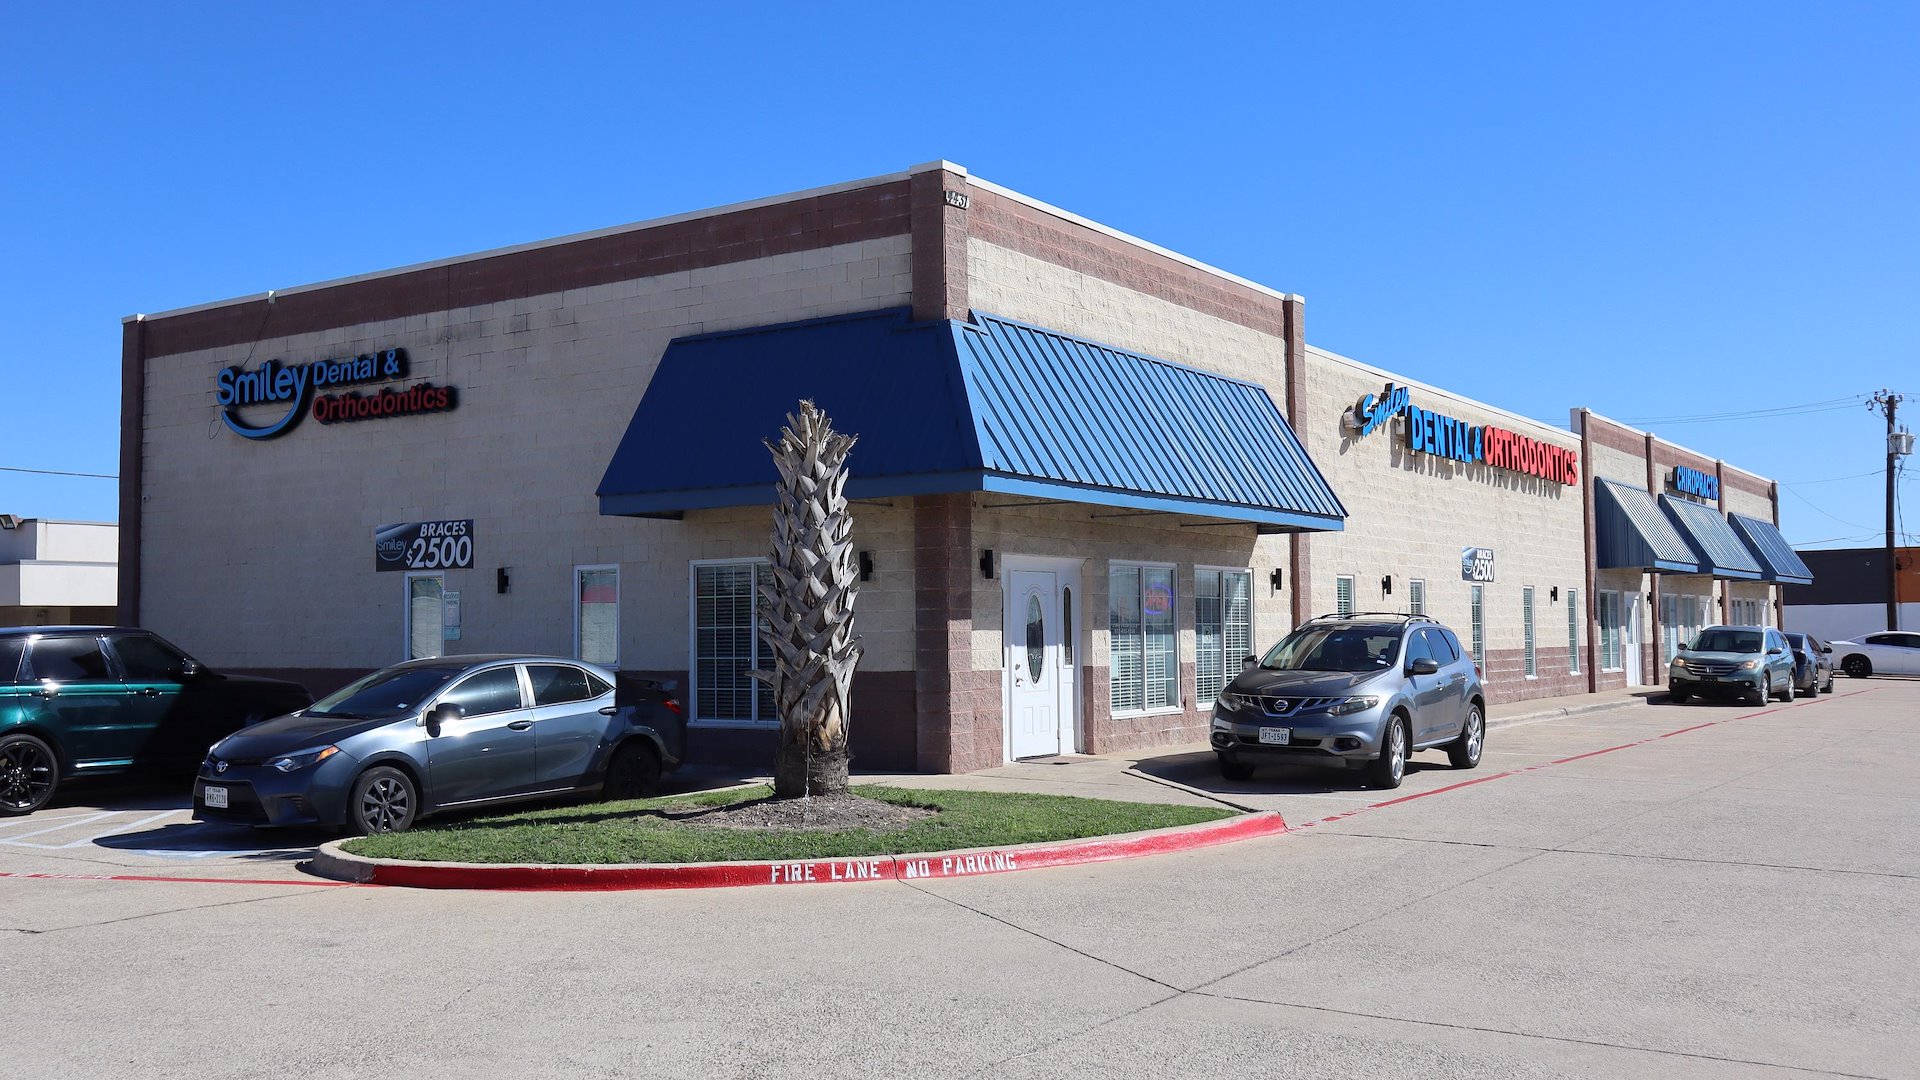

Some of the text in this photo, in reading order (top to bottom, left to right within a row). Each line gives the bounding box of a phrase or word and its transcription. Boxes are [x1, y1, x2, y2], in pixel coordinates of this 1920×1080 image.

[313, 348, 399, 386] Dental &
[216, 361, 309, 438] Smiley
[312, 384, 449, 421] Orthodontics
[1362, 382, 1410, 438] Smiley
[1411, 404, 1578, 487] DENTAL & ORTHODONTICS
[420, 521, 467, 537] BRACES
[377, 537, 408, 561] Smiley
[405, 535, 472, 569] $2500
[1472, 558, 1494, 581] $2500
[771, 861, 881, 883] FIRE LANE
[906, 853, 1017, 879] NO PARKING
